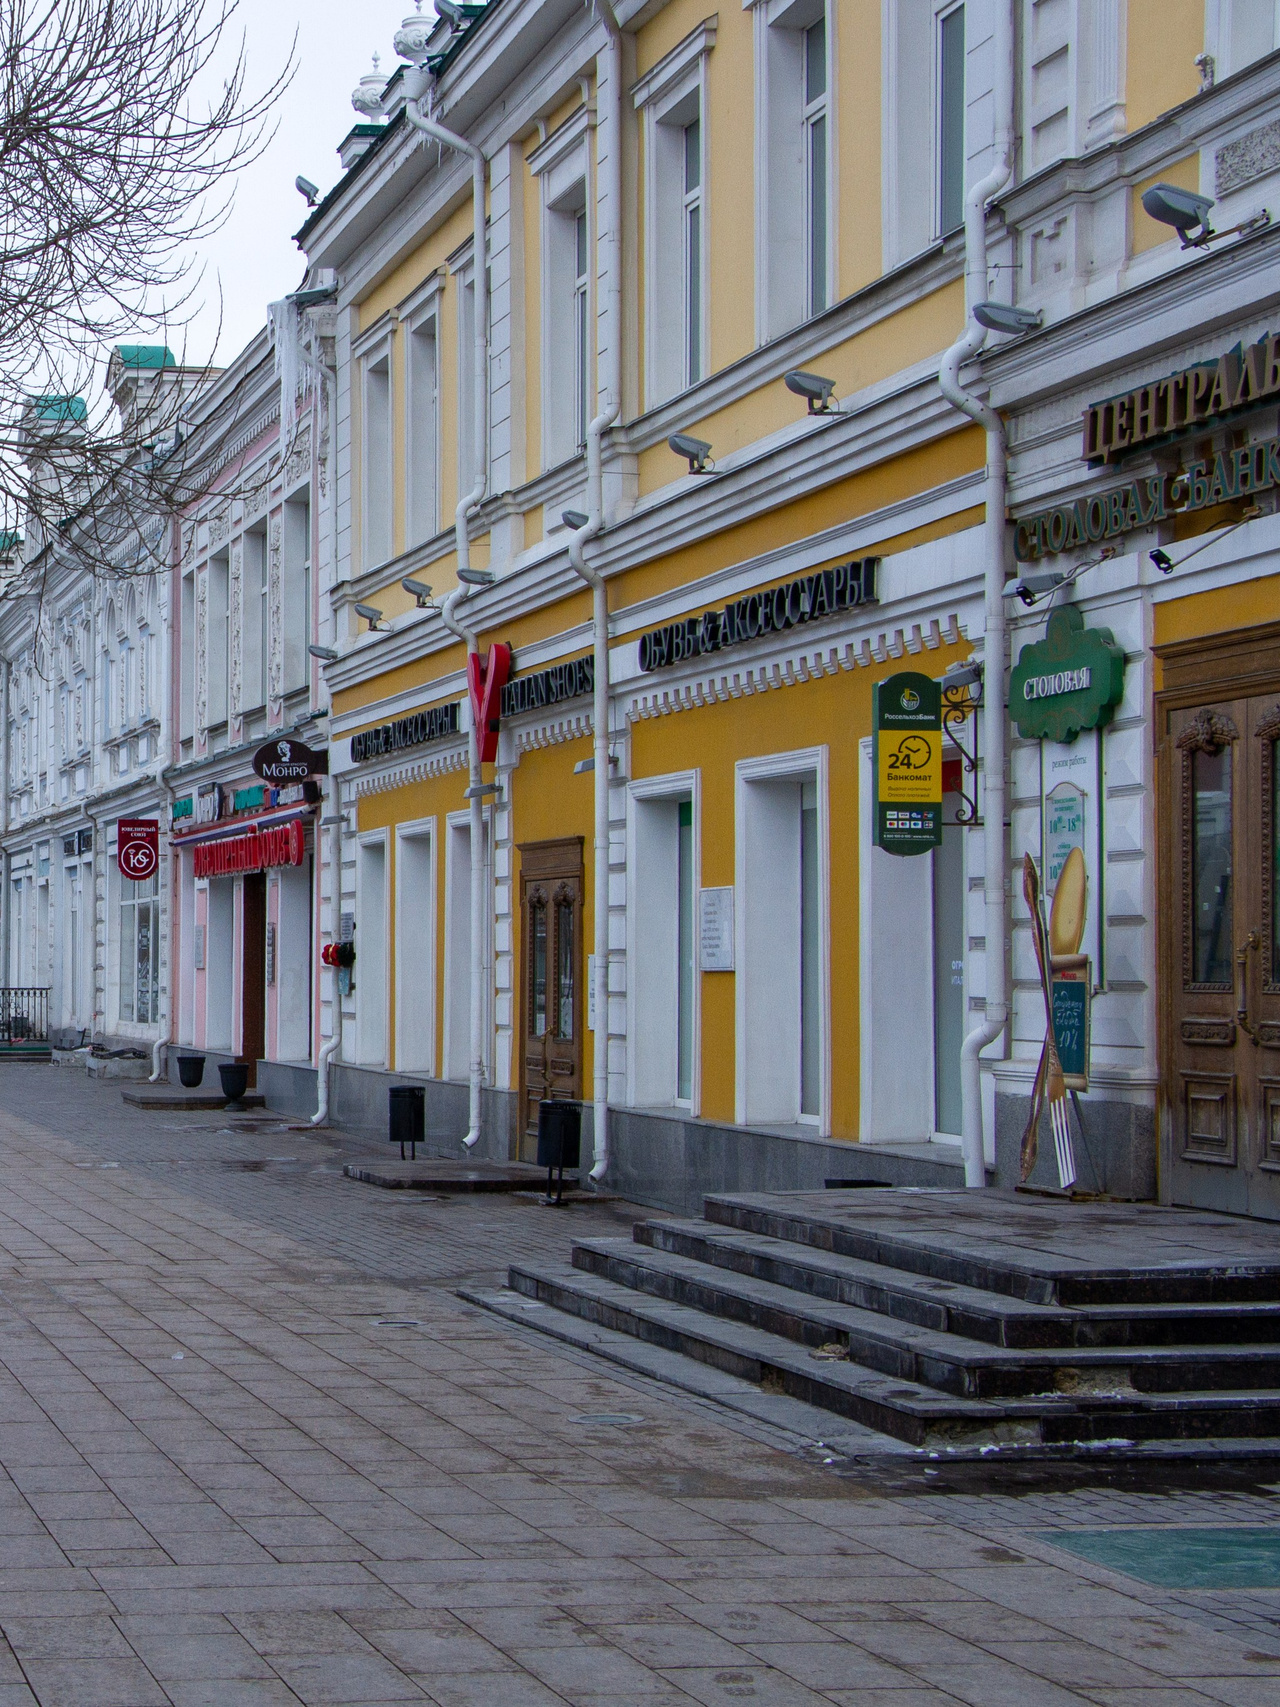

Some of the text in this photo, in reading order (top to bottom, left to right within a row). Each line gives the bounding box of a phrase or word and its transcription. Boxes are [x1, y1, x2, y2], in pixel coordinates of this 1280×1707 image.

[1013, 472, 1168, 562] СТОЛОВАЯ
[639, 556, 880, 672] ОБУВЬ & АКСЕССУАРЫ
[500, 654, 594, 718] ITALIAN SHOES
[1023, 667, 1091, 700] СТОЛОВАЯ
[390, 702, 460, 750] АКСЕССУАРЫ
[884, 713, 936, 721] РоссельхозБанк
[887, 773, 932, 781] Банкомат
[888, 753, 912, 770] 24
